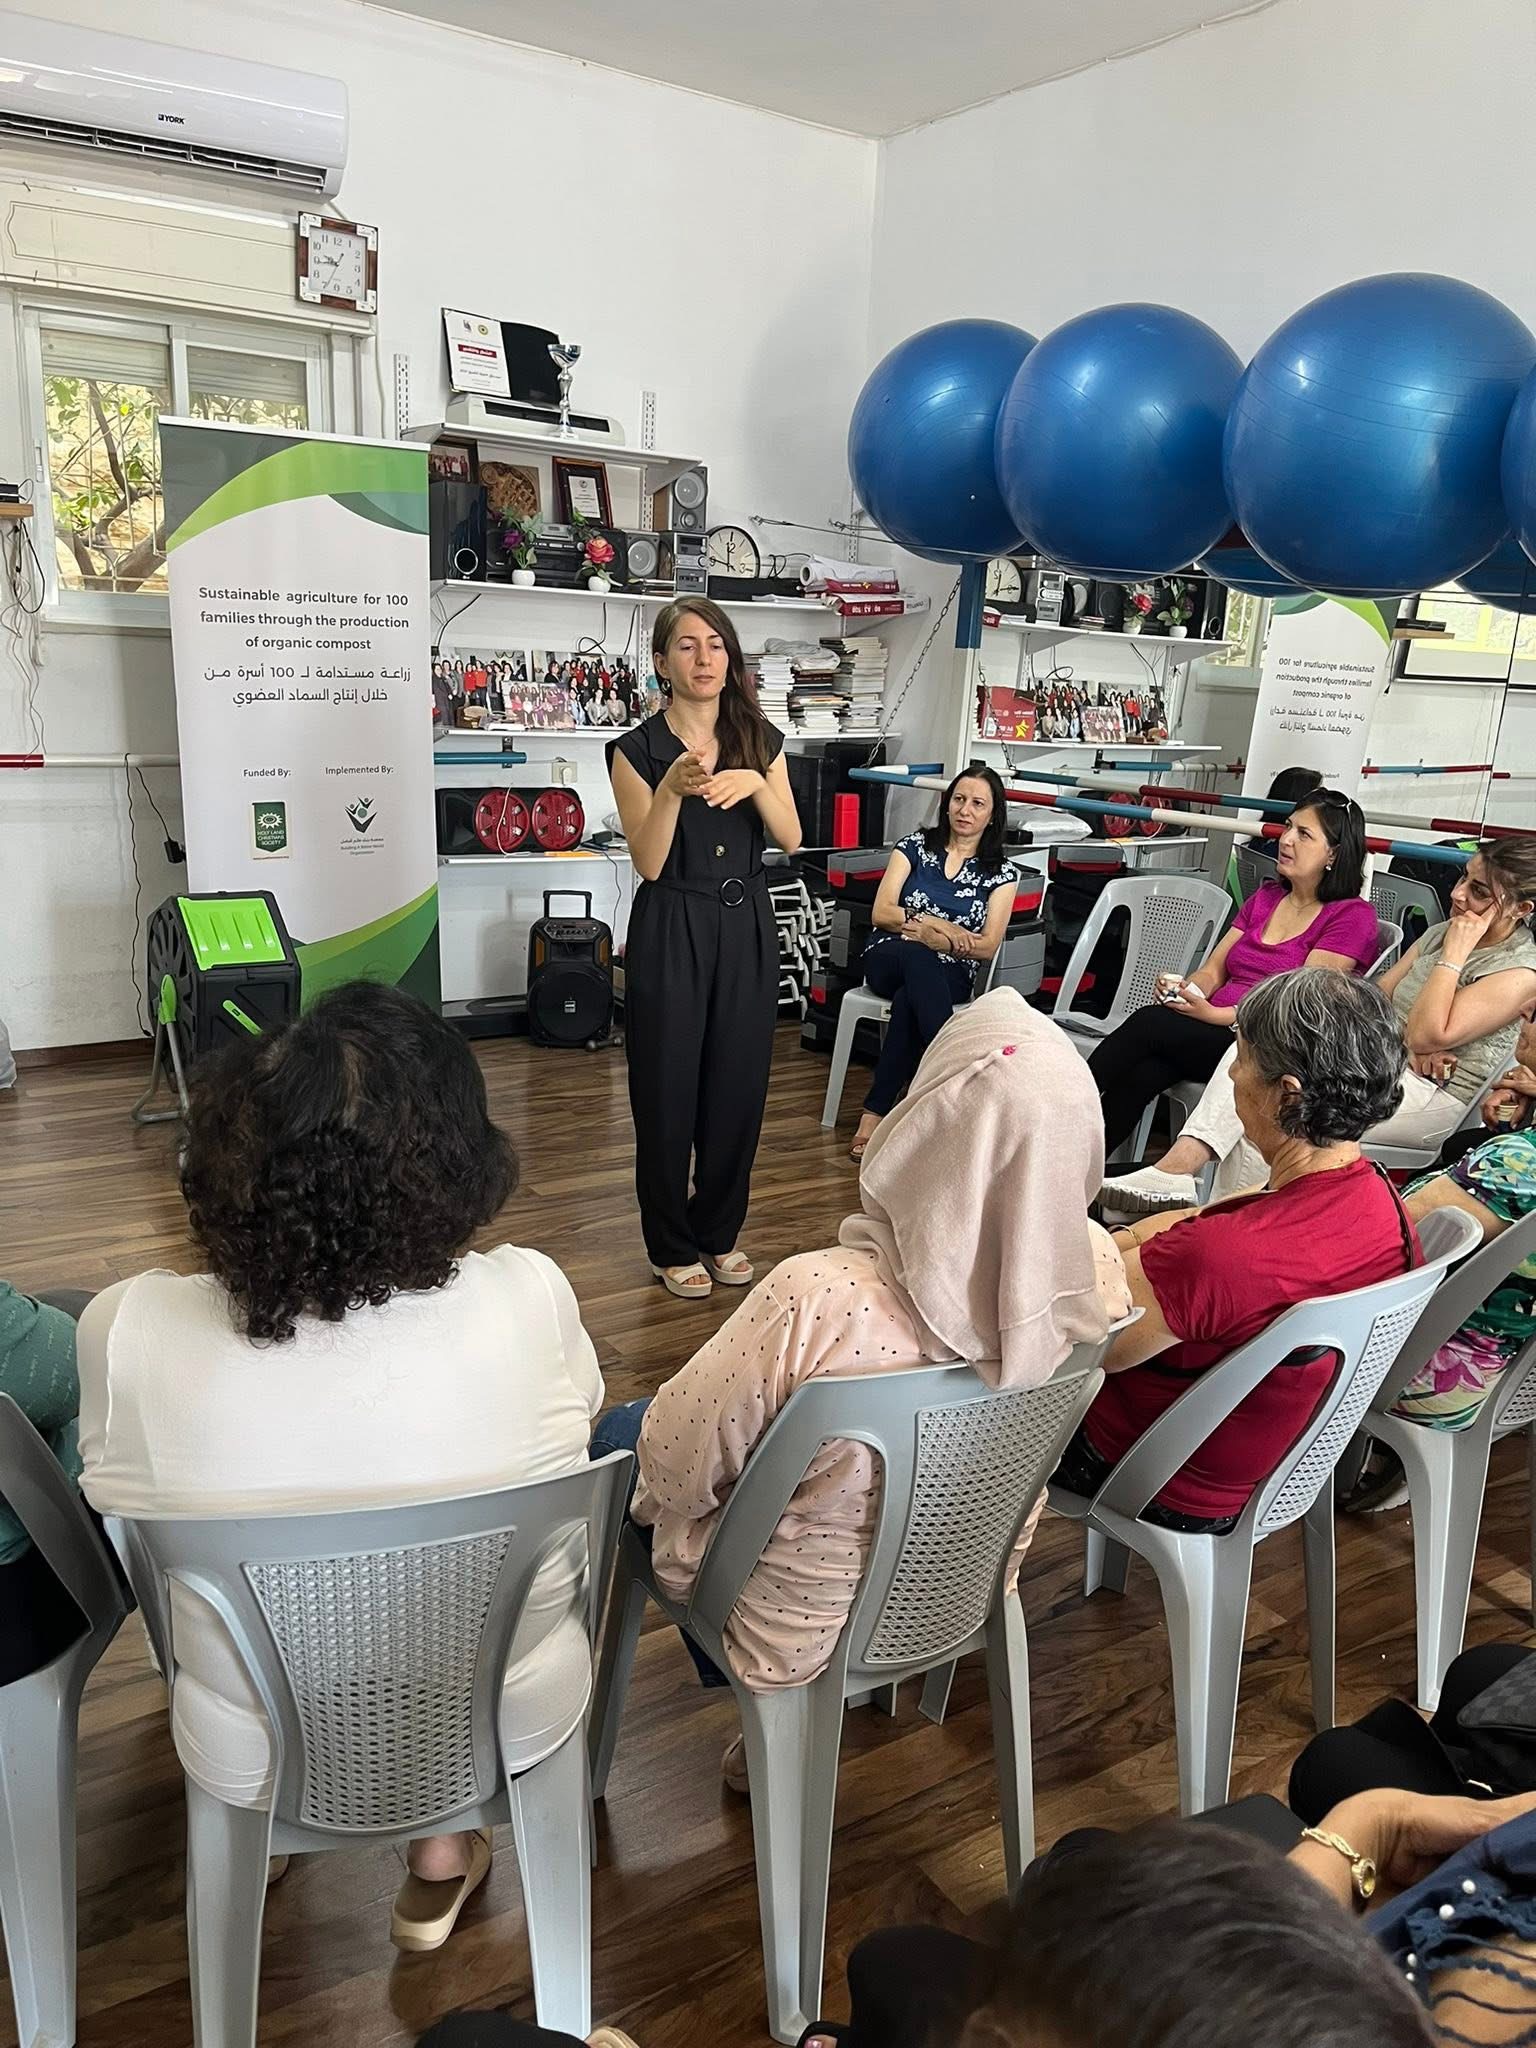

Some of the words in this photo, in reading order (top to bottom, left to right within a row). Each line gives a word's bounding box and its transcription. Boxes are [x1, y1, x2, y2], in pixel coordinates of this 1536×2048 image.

[164, 114, 185, 124] YORK
[726, 541, 736, 554] 12
[739, 562, 746, 574] 3
[199, 587, 280, 602] Sustainable
[286, 591, 358, 605] agriculture
[363, 593, 381, 605] for
[386, 594, 409, 606] 100
[200, 611, 255, 624] families
[258, 613, 313, 628] through
[315, 615, 337, 626] the
[339, 616, 409, 629] production
[245, 636, 260, 648] of
[262, 637, 313, 650] organic
[315, 639, 372, 651] compost
[204, 667, 231, 681] من
[237, 663, 265, 681] أسرة
[270, 667, 295, 678] 100
[316, 666, 375, 679] مستدامة
[380, 665, 411, 682] زراعة
[232, 689, 284, 707] العضوي
[288, 689, 329, 701] السماد
[333, 688, 358, 705] إنتاج
[361, 688, 388, 703] خلال
[243, 768, 276, 778] Funded
[277, 768, 292, 778] By:
[325, 766, 380, 776] Implemented
[381, 765, 394, 775] By:
